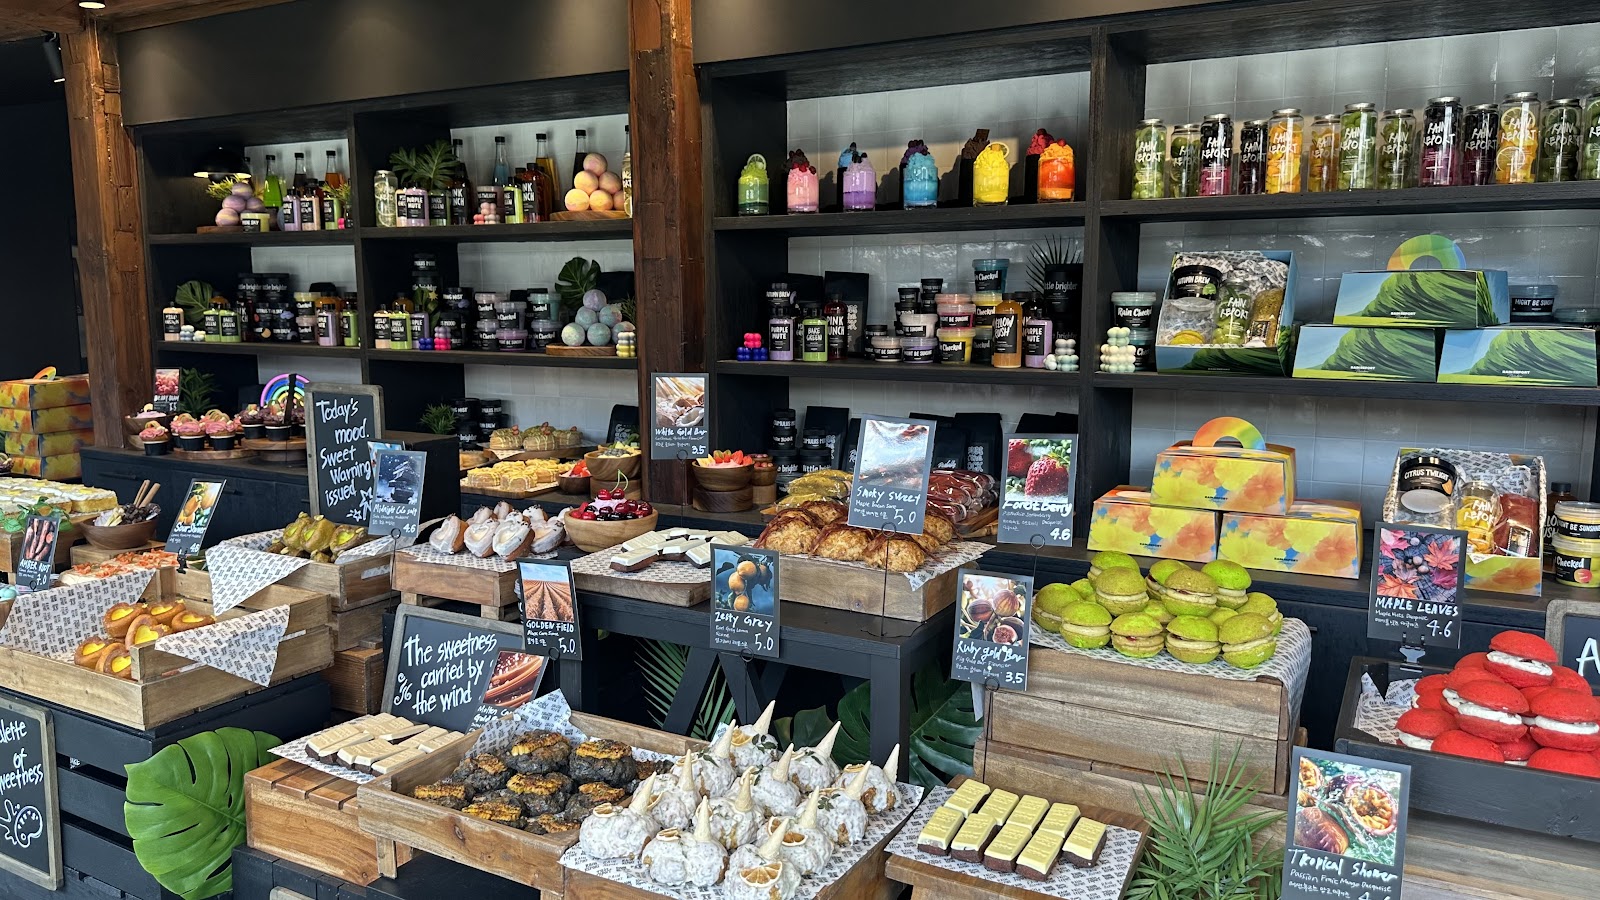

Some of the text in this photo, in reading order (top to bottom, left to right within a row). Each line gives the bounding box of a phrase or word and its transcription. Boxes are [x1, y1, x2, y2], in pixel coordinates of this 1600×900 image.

[1427, 122, 1446, 134] RAIN
[1509, 117, 1532, 130] RAIN
[1273, 132, 1292, 144] RAIN
[1423, 133, 1455, 146] REPORT
[1472, 128, 1494, 139] RAIN
[1501, 129, 1536, 143] REPORT
[1139, 141, 1157, 151] RAIN
[1206, 136, 1226, 148] RAIN
[1339, 138, 1371, 150] REPORT
[1465, 139, 1498, 151] REPORT
[1201, 147, 1230, 159] REPORT
[1268, 143, 1298, 155] REPORT
[1134, 151, 1162, 162] REPORT
[522, 182, 533, 192] NK
[523, 192, 535, 202] NCH
[1194, 275, 1211, 284] BREW
[1228, 296, 1247, 308] RAIN
[1515, 298, 1540, 307] MIGHT BE
[1117, 307, 1133, 317] Rain
[1220, 307, 1249, 319] REPORT
[770, 326, 789, 334] PURPLE
[807, 327, 821, 335] BAKE
[316, 397, 359, 424] Today's
[335, 418, 370, 445] mood.
[691, 444, 707, 455] 3.5
[320, 444, 357, 470] Sweet
[329, 461, 372, 485] Warning
[1404, 468, 1449, 481] CITRUS TWILIGHT
[324, 479, 357, 508] issued
[893, 508, 917, 525] 5.0
[1569, 523, 1578, 531] BE
[1049, 527, 1071, 541] 4.6
[1556, 555, 1585, 569] Checked
[36, 573, 47, 586] 7.0
[1375, 596, 1459, 617] MAPLE LEAVES
[1375, 609, 1392, 618] Maple
[526, 619, 575, 633] GOLDEN FIELD
[714, 611, 773, 633] Zesty Grey
[1426, 619, 1453, 638] 4.6
[558, 637, 576, 654] 5.0
[754, 632, 774, 651] 5.0
[404, 633, 433, 667] The
[436, 632, 498, 664] sweetness
[956, 640, 982, 660] Ruby
[1003, 645, 1026, 663] Bar
[420, 658, 485, 689] carried by
[1005, 671, 1025, 684] 3.5
[412, 680, 473, 716] the wind
[13, 747, 28, 772] of
[0, 763, 44, 796] weetness
[1288, 849, 1398, 882] Tropical Shower
[1290, 868, 1319, 883] Passion
[1339, 878, 1361, 889] Mango
[1361, 881, 1392, 892] Dacquoise
